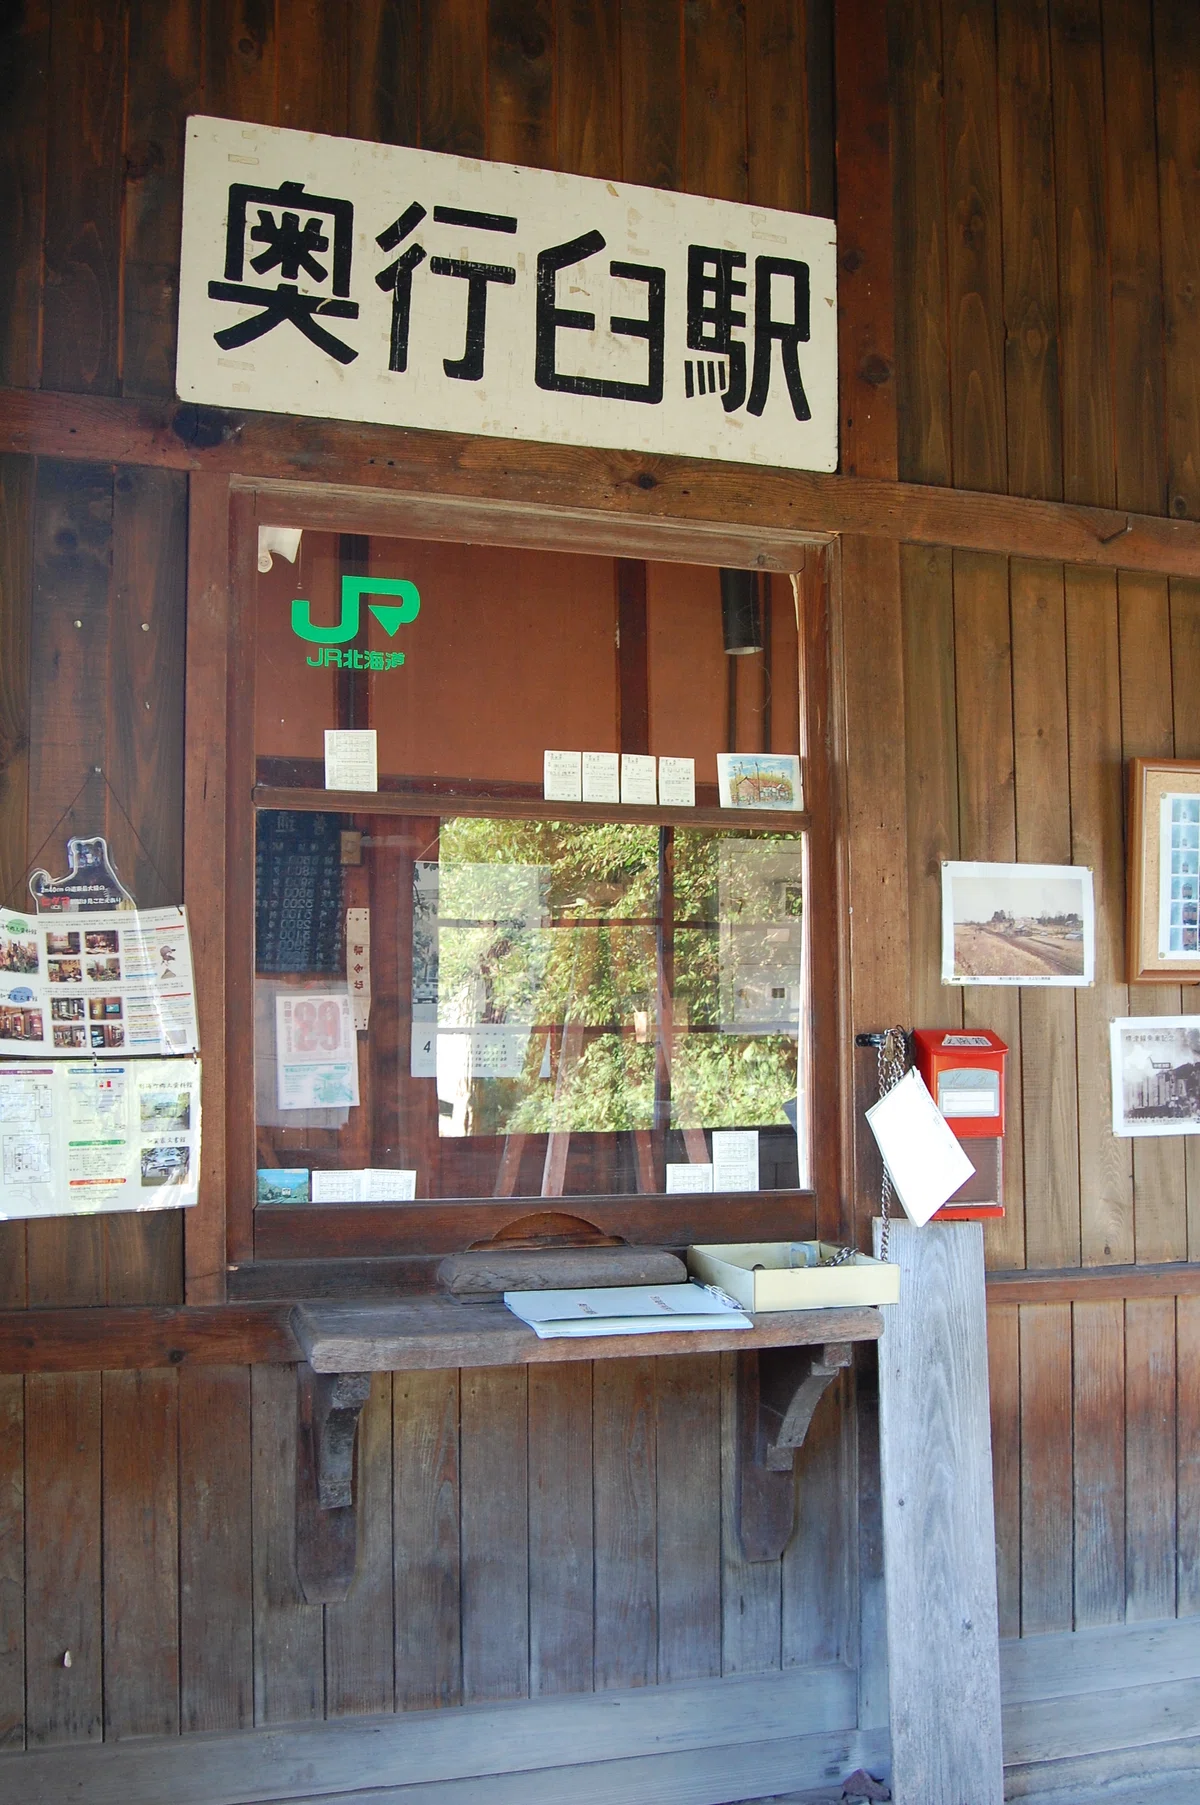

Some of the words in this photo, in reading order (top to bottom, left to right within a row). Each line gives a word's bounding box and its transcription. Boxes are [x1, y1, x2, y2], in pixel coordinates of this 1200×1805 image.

[207, 180, 812, 421] 奥行臼駅
[291, 575, 421, 644] JR
[306, 647, 406, 671] JR北海道
[423, 1040, 432, 1053] 4
